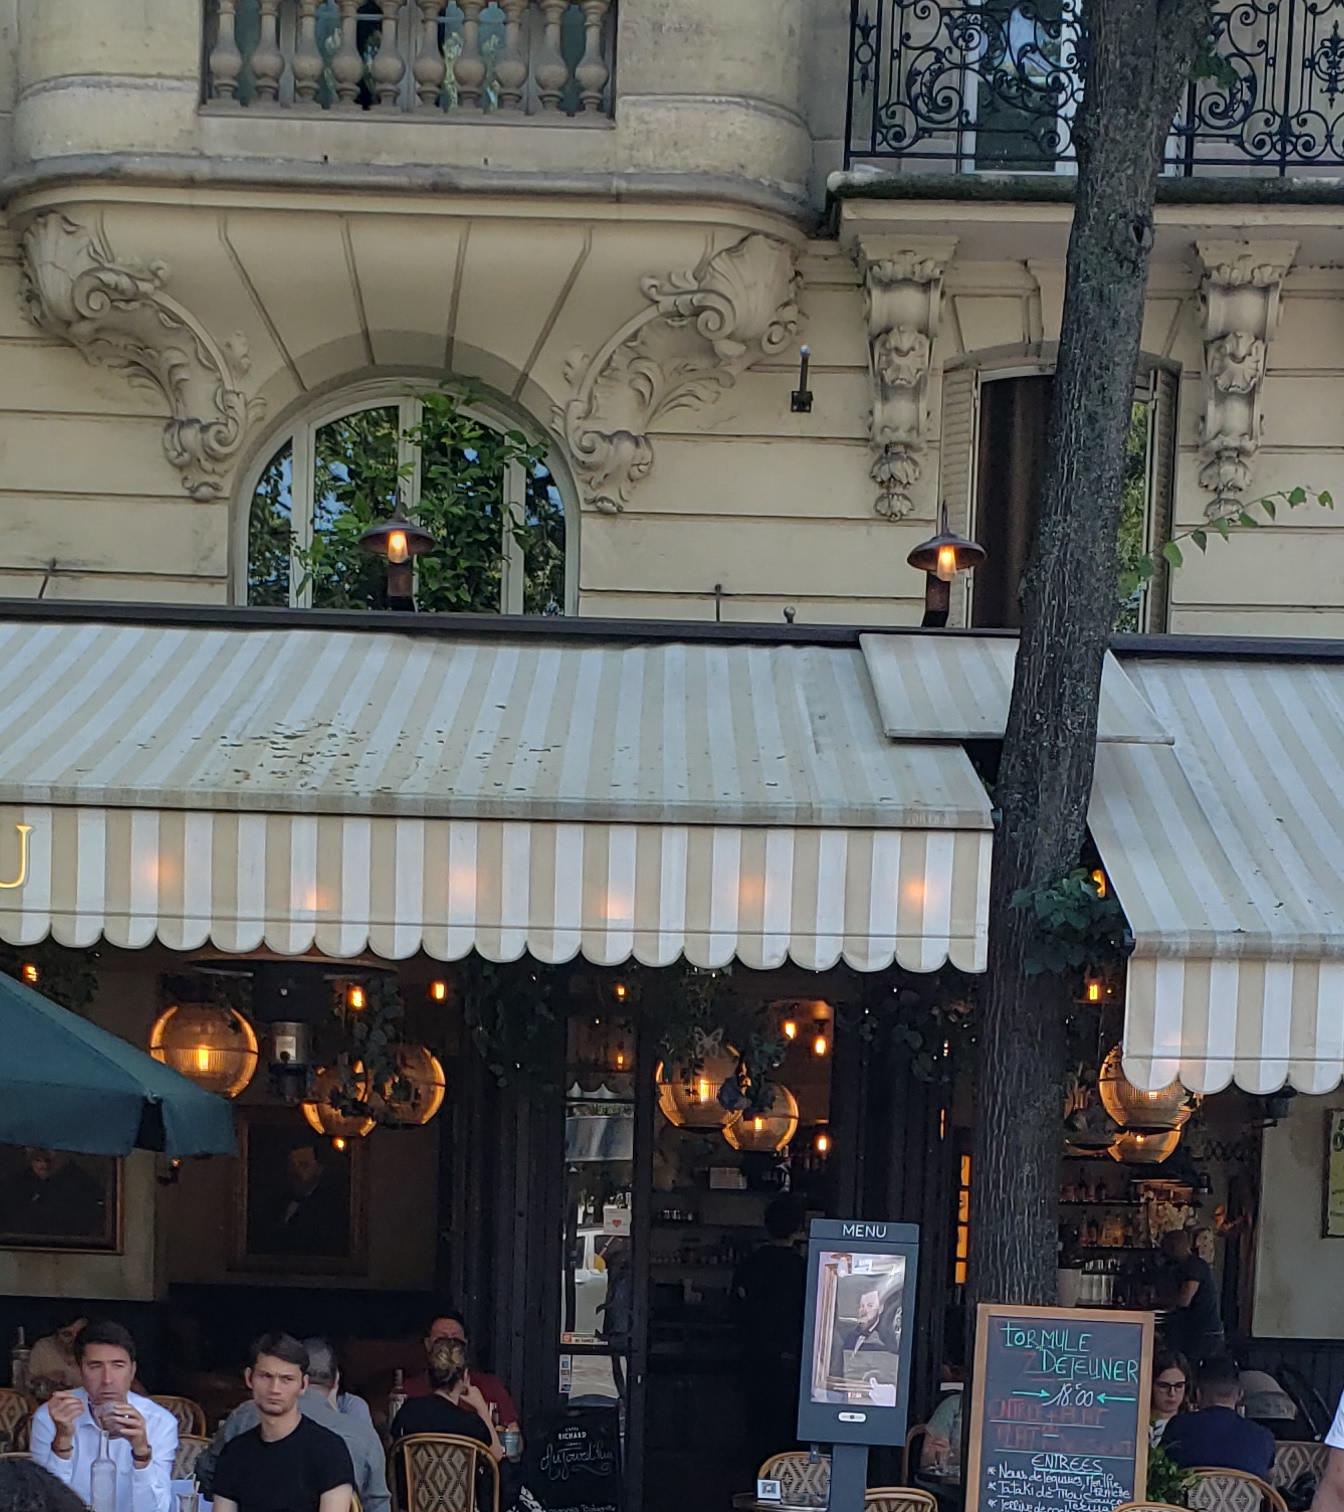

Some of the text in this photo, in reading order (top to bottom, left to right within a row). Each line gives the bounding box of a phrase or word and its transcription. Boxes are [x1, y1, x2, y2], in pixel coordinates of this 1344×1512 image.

[842, 1223, 887, 1238] MENU
[558, 1431, 587, 1440] RICHARD
[1031, 1453, 1103, 1473] ENTREES
